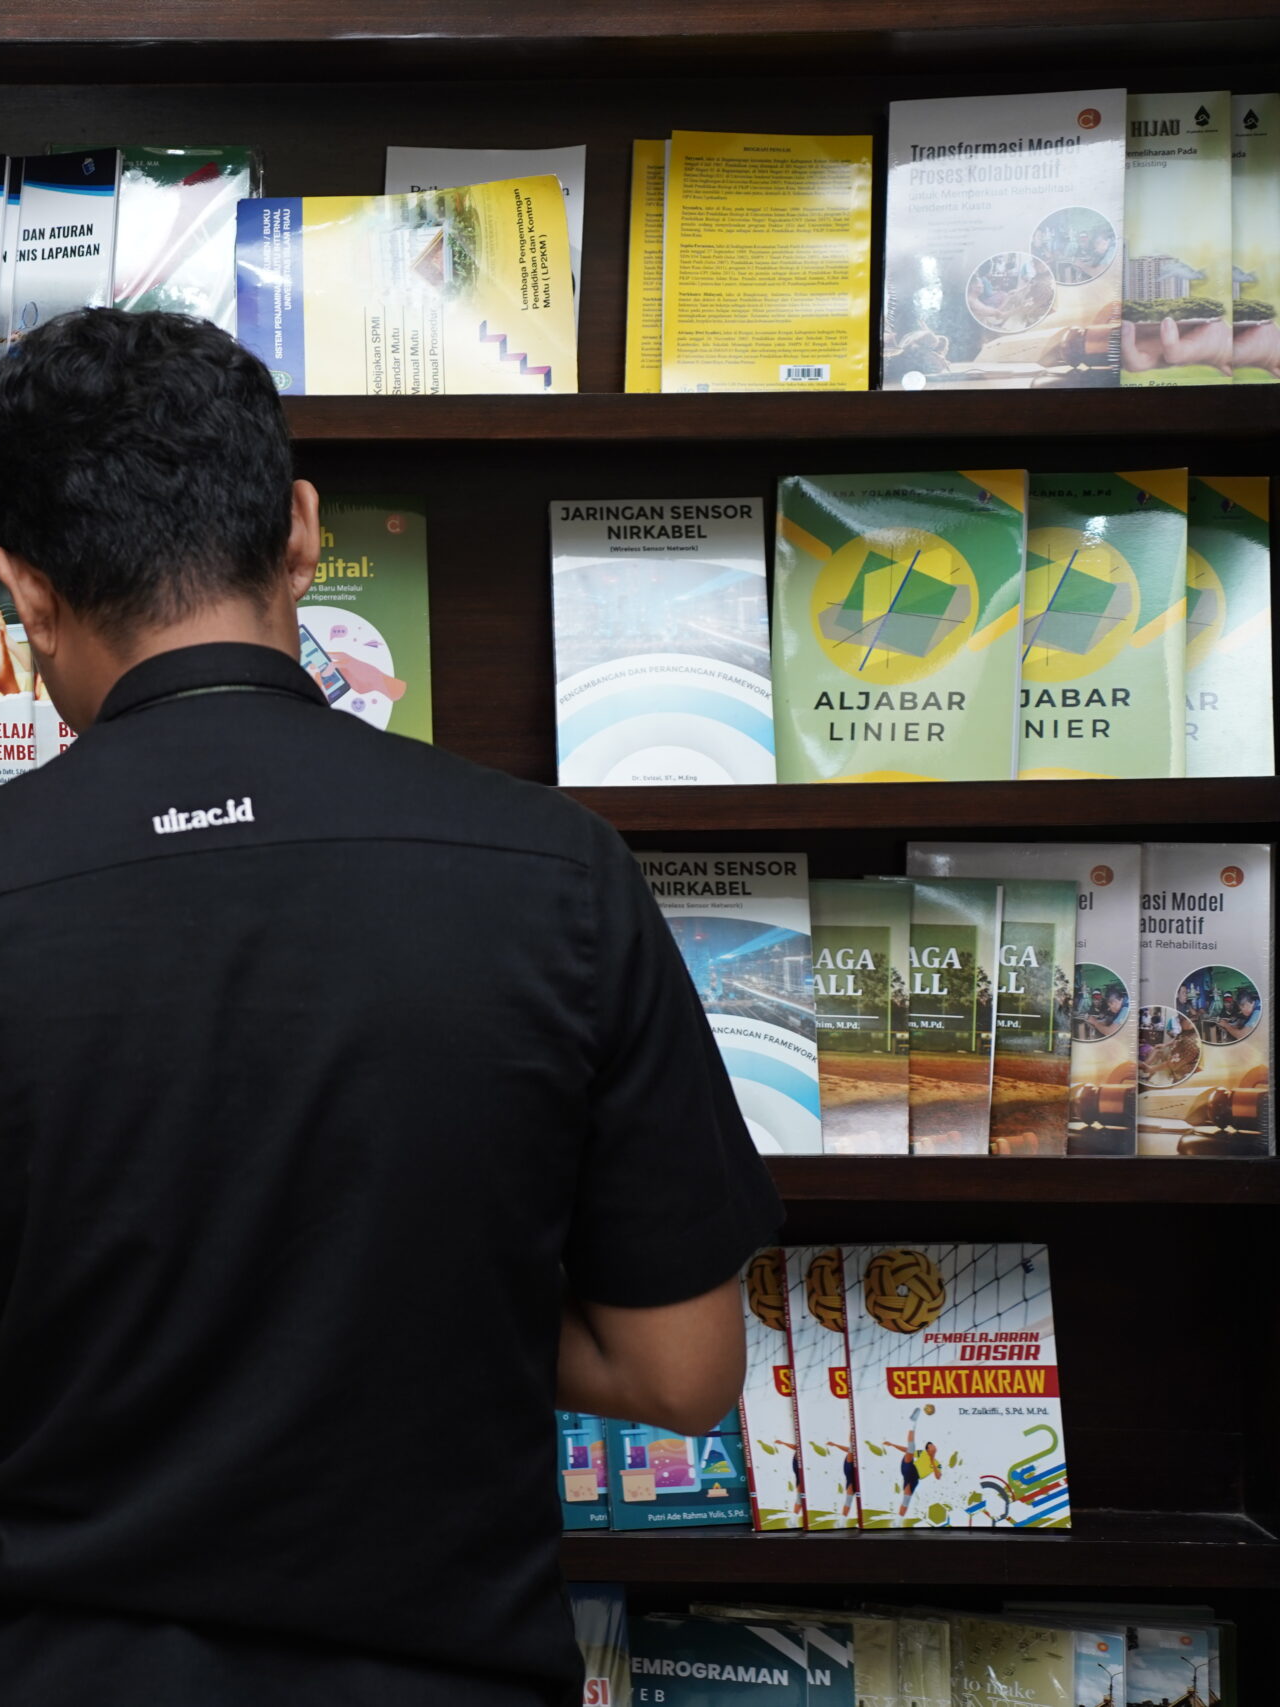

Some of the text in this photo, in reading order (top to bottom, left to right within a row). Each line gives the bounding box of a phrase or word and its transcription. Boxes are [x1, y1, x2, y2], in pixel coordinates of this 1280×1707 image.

[1130, 119, 1181, 138] HIJAU
[1028, 136, 1081, 157] Model
[1177, 147, 1198, 156] Pada
[263, 209, 271, 235] BUKU
[283, 208, 291, 230] RIAU
[524, 197, 535, 233] Kontrol
[22, 223, 93, 242] DAN ATURAN
[41, 243, 100, 260] LAPANGAN
[513, 188, 529, 311] Lembaga Pengembangan
[529, 255, 539, 310] Pendidikan
[543, 283, 551, 308] Mutu
[274, 330, 283, 359] SISTEM
[371, 316, 384, 395] Kebijakan SPMI
[391, 328, 402, 395] Standar Mutu
[410, 330, 420, 395] Manual Mutu
[430, 359, 439, 395] Manual
[560, 504, 753, 521] JARINGAN SENSOR
[607, 525, 707, 540] NIRKABEL
[311, 594, 357, 602] Hiperrealitas
[559, 665, 771, 705] PENGEMBANGAN DAN PERANCANGAN FRAMEWORK
[814, 690, 966, 711] ALJABAR
[829, 722, 945, 742] LINIER
[1024, 718, 1111, 739] NIER
[152, 797, 255, 834] uir.ac.id
[714, 861, 797, 876] SENSOR
[652, 881, 752, 896] NIRKABEL
[1172, 892, 1224, 911] Model
[1155, 939, 1218, 950] Rehabilitasi
[836, 1021, 860, 1030] M.Pd.
[921, 1020, 944, 1030] M.Pd.
[763, 1034, 817, 1064] FRAMEWORK
[924, 1332, 1040, 1344] PEMBELAJARAN
[960, 1344, 1041, 1361] DASAR
[893, 1369, 1046, 1395] SEPAKTAKRAW
[959, 1407, 1050, 1416] Dr. S.Pd. M.Pd.
[648, 1511, 708, 1522] Putri Ade Rahma
